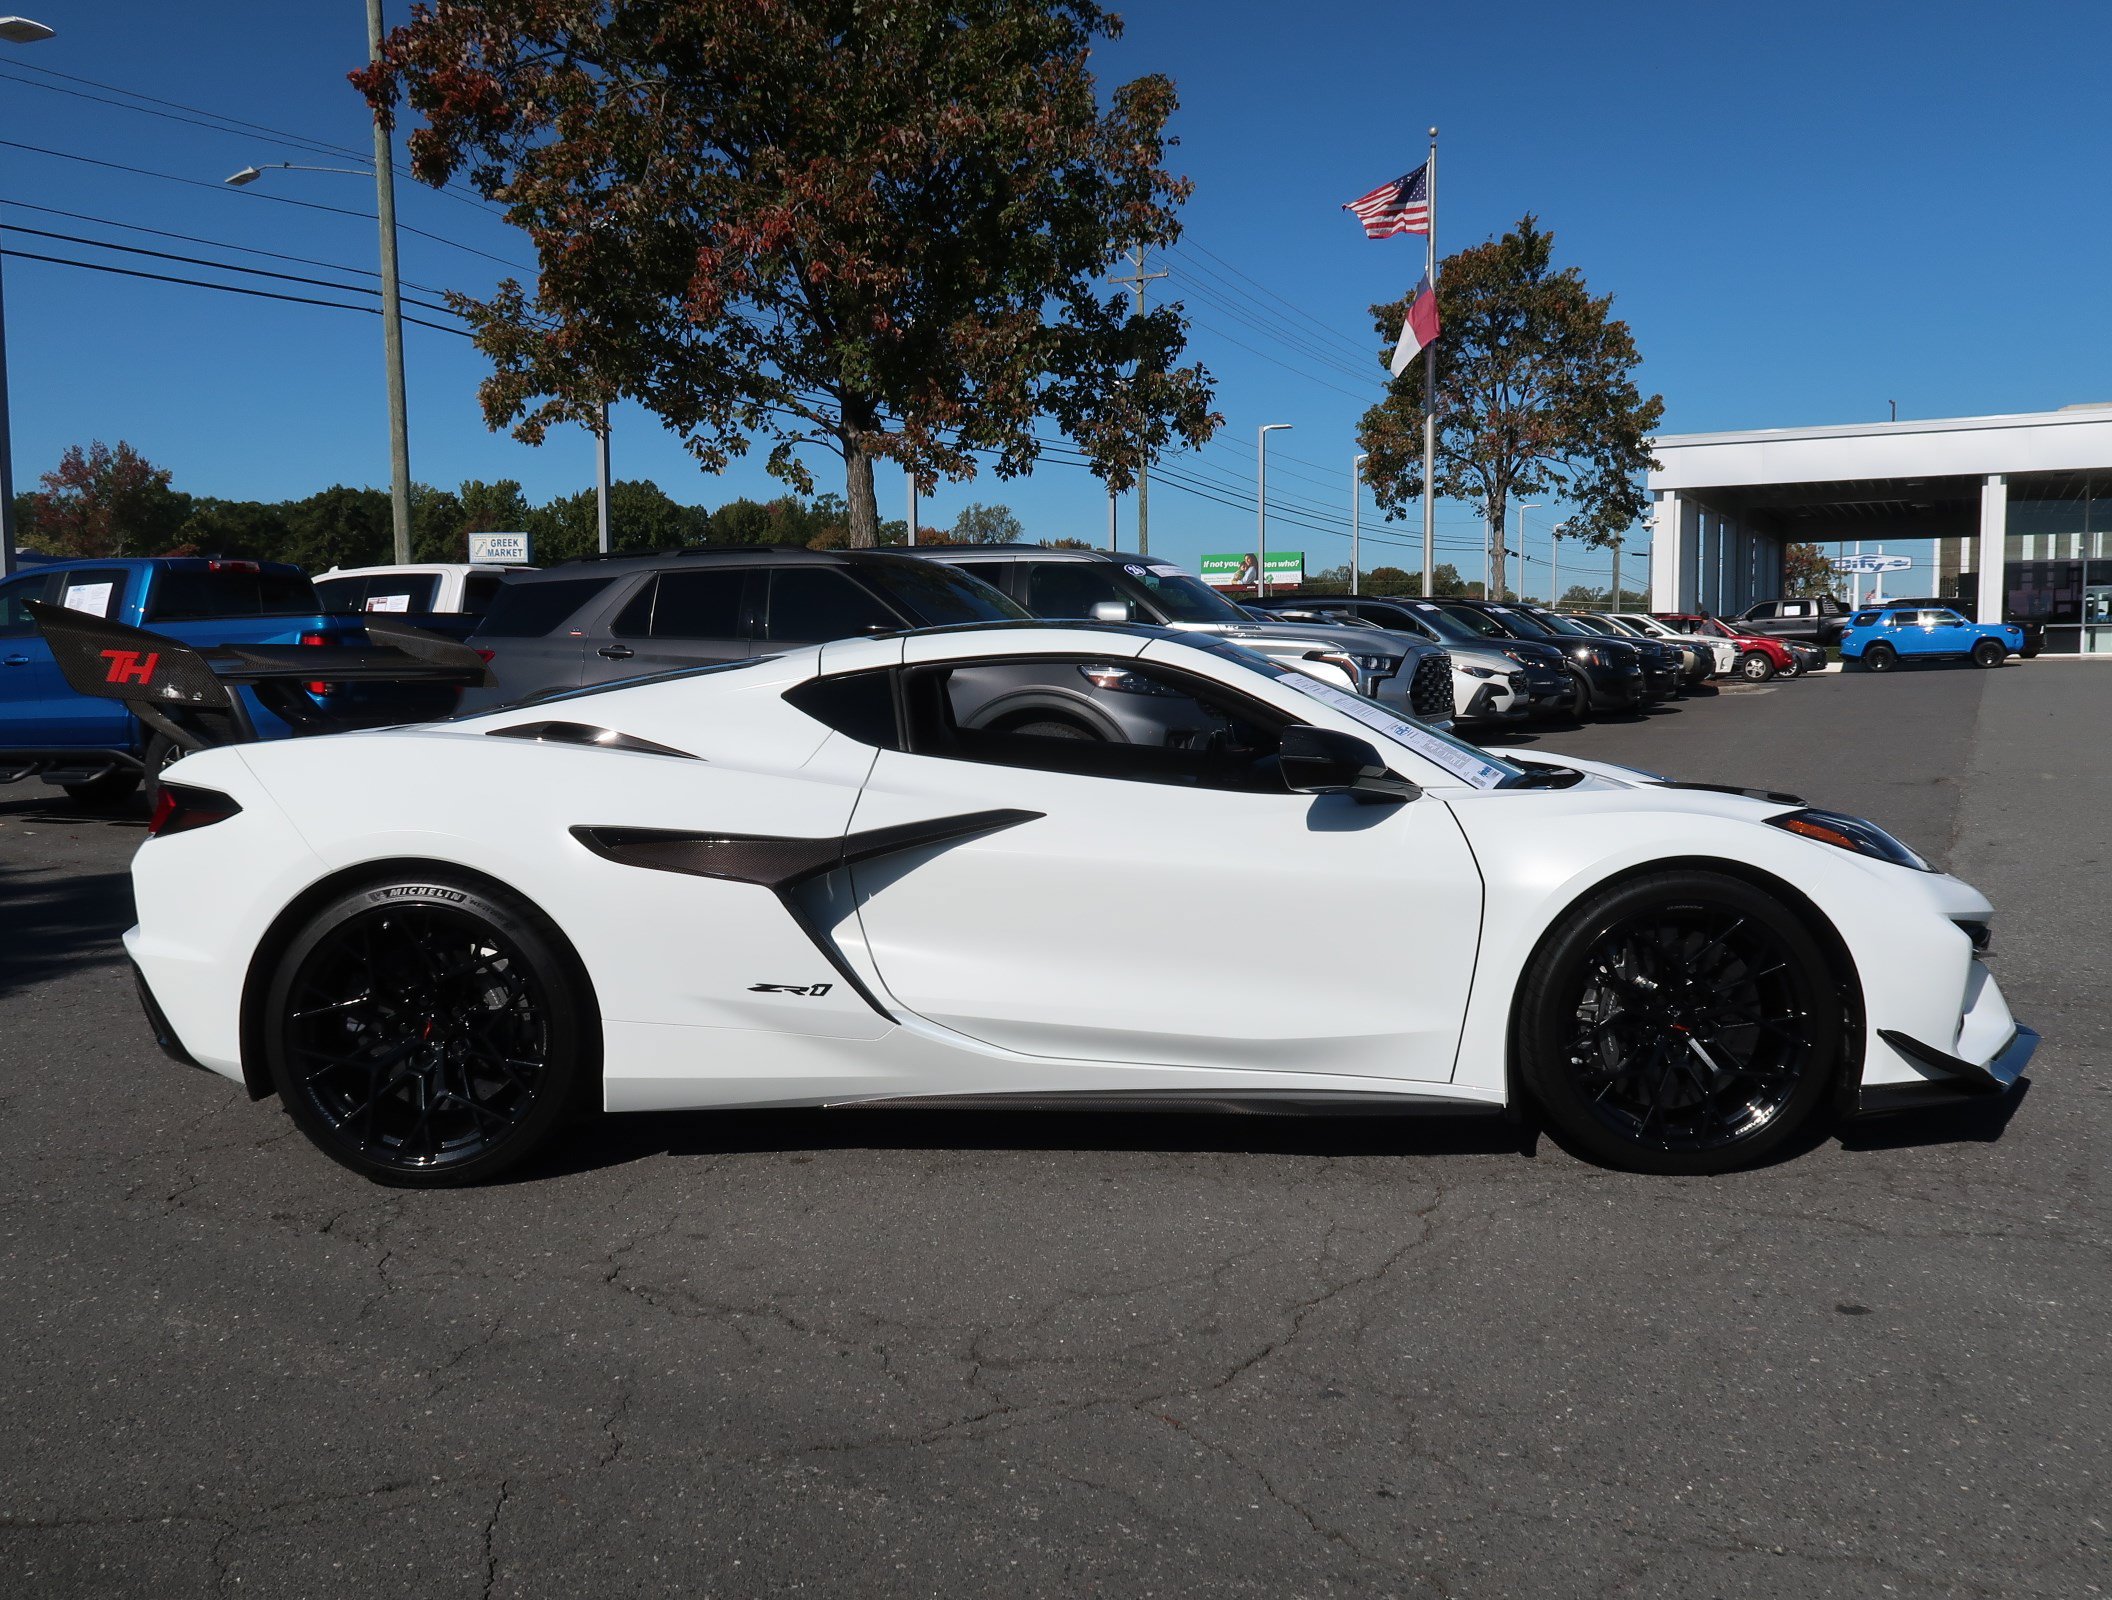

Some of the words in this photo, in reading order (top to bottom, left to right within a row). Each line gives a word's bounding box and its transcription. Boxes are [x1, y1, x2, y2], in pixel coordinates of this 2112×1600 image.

[490, 539, 519, 547] GREEK
[487, 549, 523, 557] MARKET
[1224, 561, 1240, 569] you,
[1278, 560, 1299, 568] who?
[100, 650, 160, 685] TH
[389, 887, 462, 901] MICHELIN
